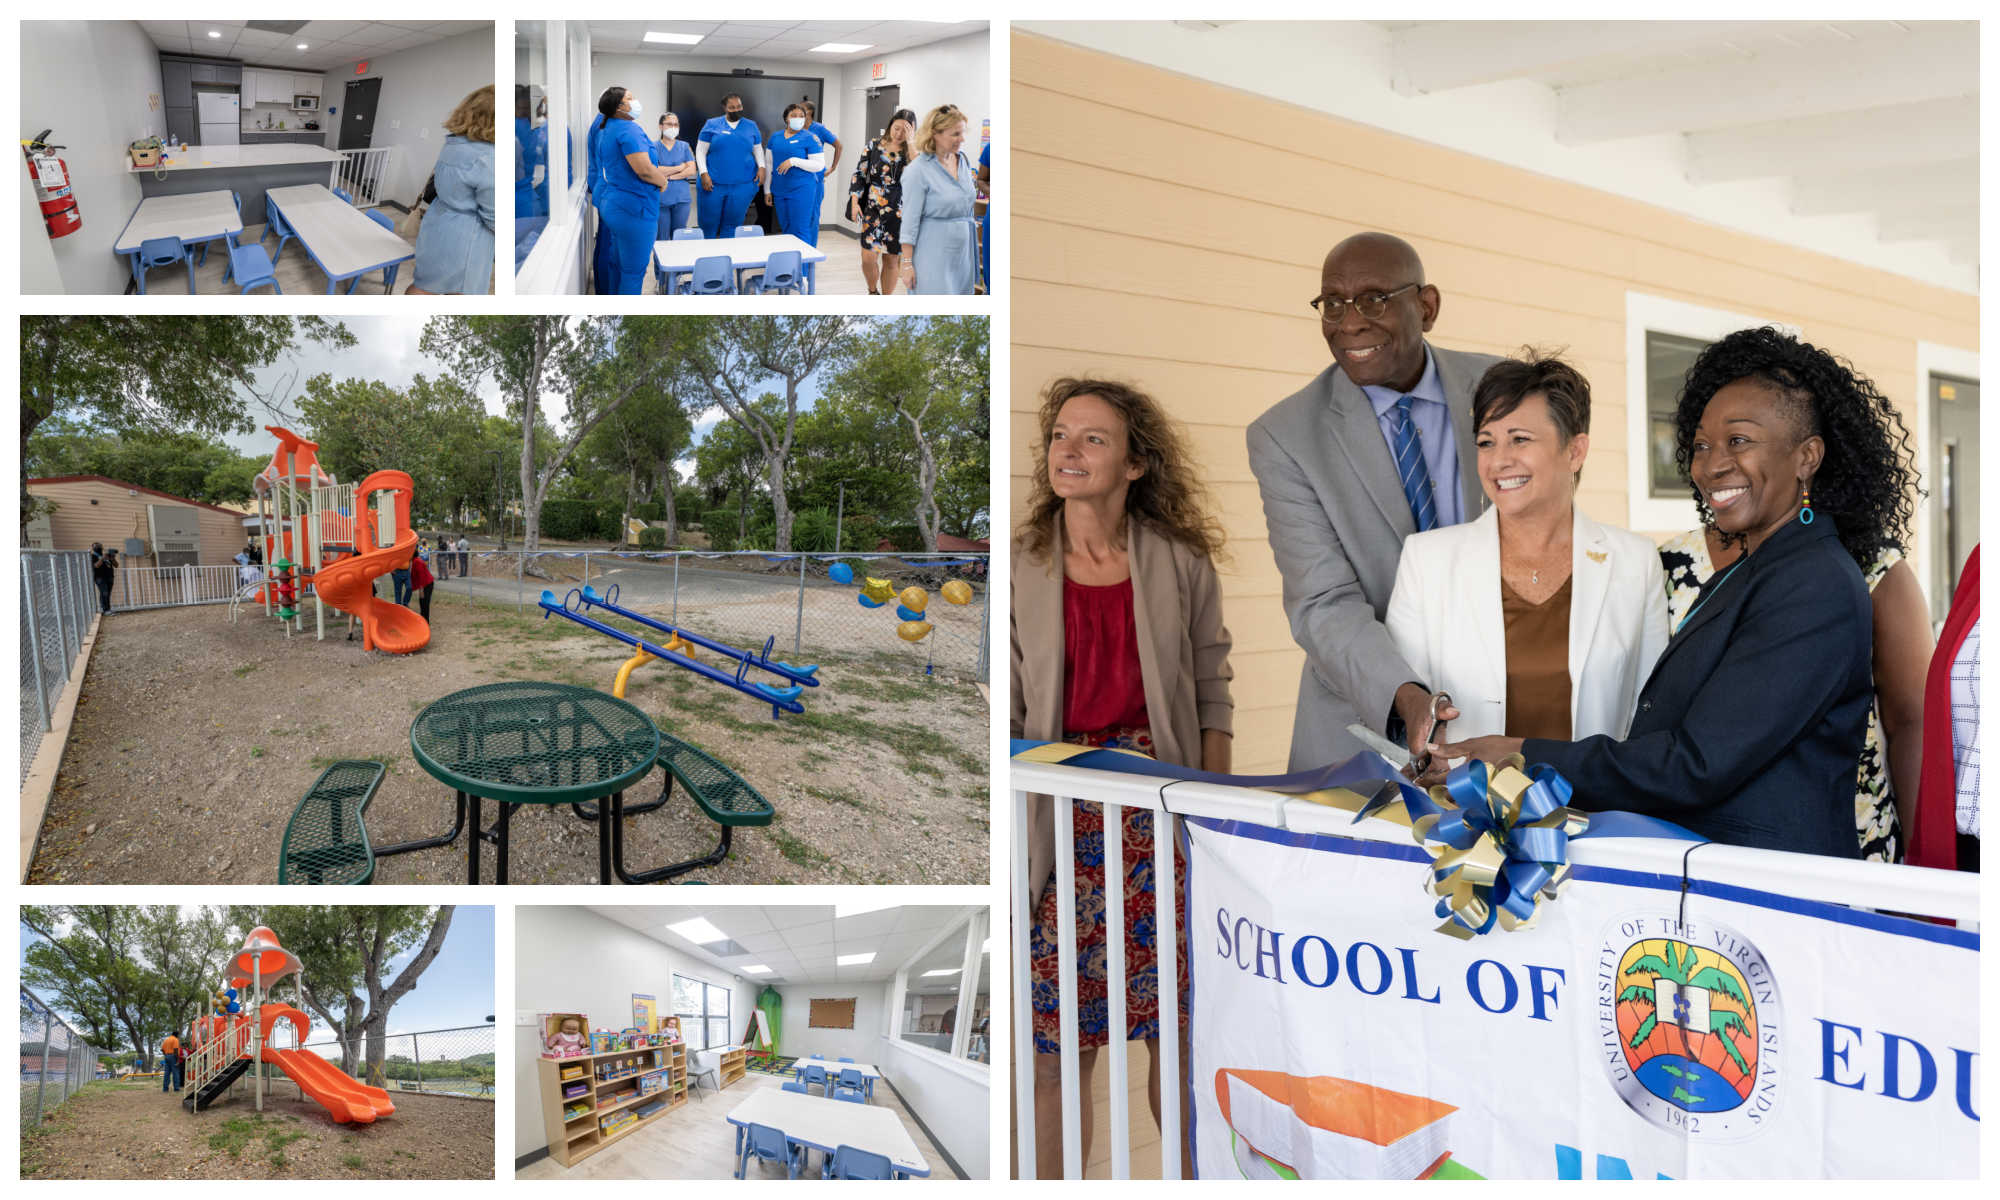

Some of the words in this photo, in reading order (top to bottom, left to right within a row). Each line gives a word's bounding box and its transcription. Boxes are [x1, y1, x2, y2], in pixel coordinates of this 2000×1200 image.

[1216, 907, 1441, 1004] SCHOOL
[1466, 959, 1566, 1022] OF
[1599, 941, 1628, 1082] UNIVERSITY
[1621, 919, 1645, 938] OF
[1659, 918, 1696, 940] THE
[1714, 930, 1774, 1004] VIRGIN
[1748, 1023, 1778, 1124] ISLANDS
[1666, 1107, 1700, 1133] 1962
